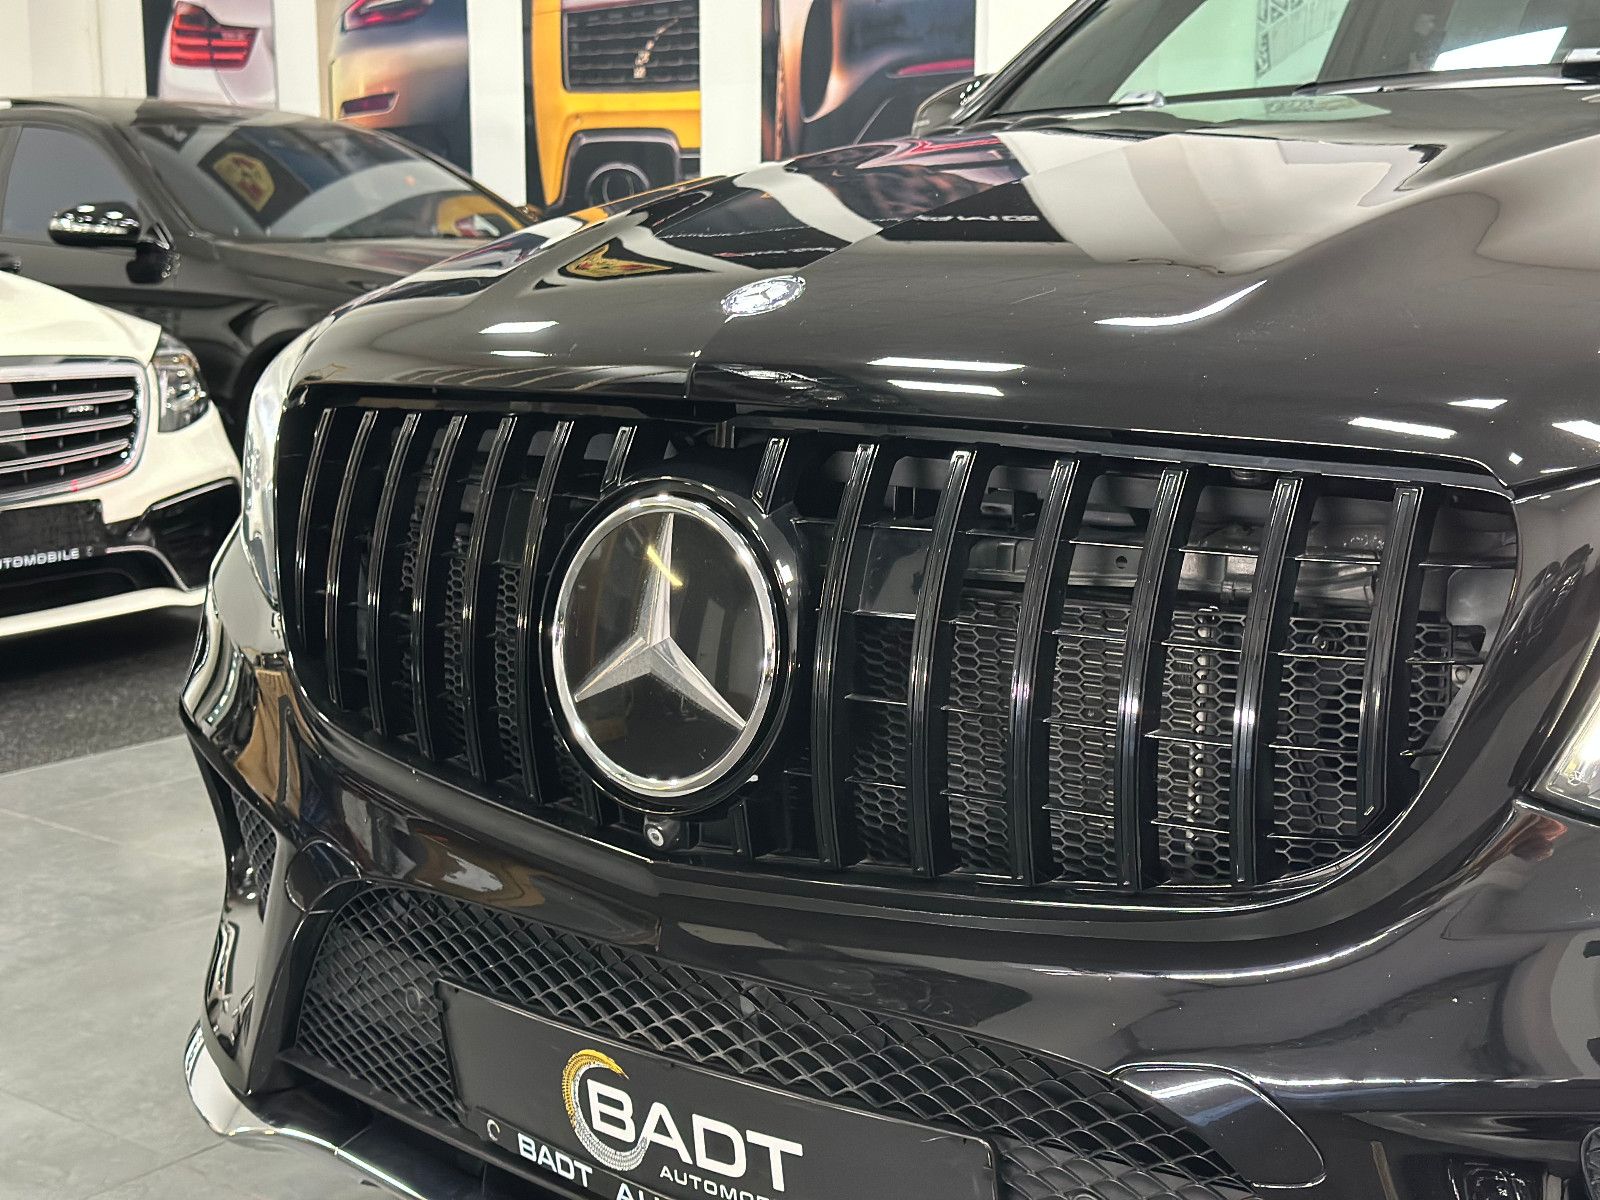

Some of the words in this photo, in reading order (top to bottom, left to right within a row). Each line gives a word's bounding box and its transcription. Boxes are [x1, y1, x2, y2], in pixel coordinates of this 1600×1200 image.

[0, 547, 80, 570] TOMOBILE
[517, 1132, 593, 1188] BADT
[586, 1078, 804, 1192] BADT
